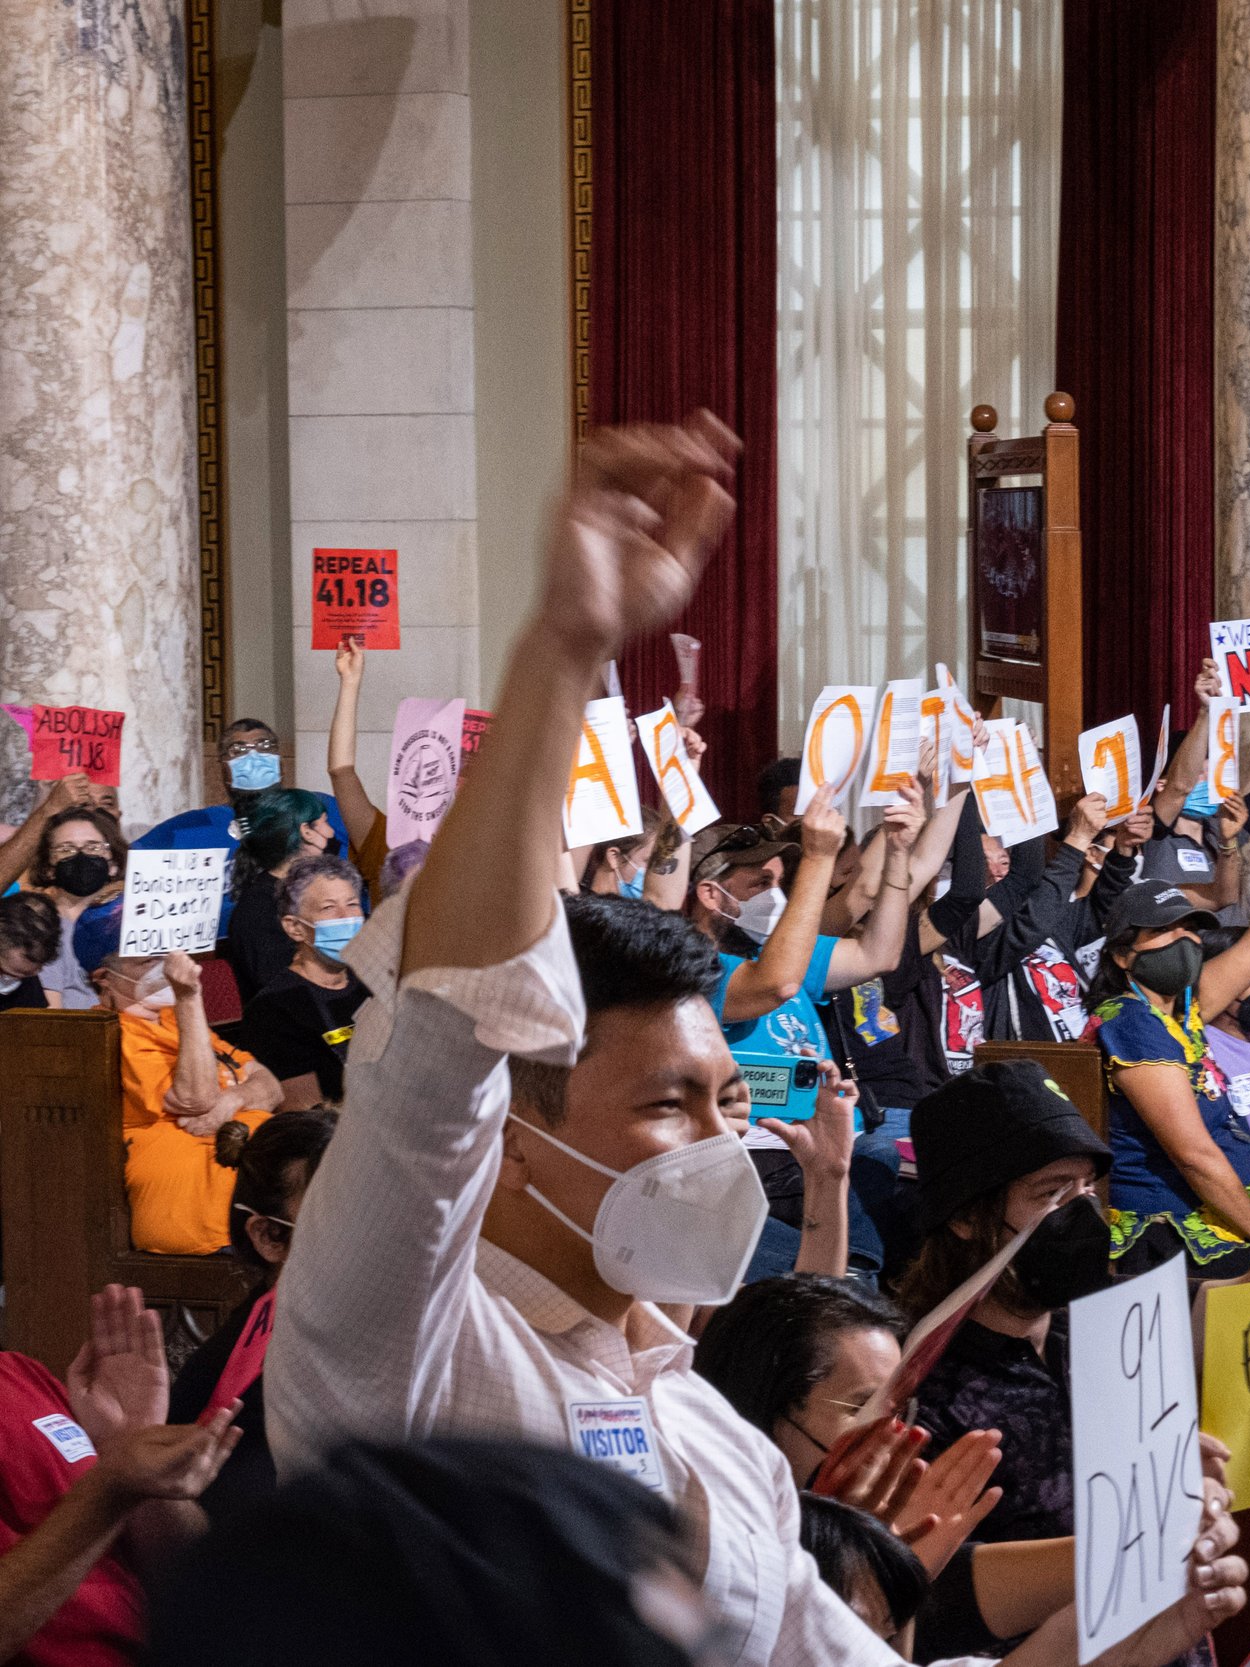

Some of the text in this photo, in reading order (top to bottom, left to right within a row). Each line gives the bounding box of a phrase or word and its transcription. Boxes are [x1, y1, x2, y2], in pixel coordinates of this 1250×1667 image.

[315, 556, 393, 574] REPEAL
[317, 578, 389, 607] 41.18
[36, 709, 125, 739] ABOLISH
[463, 721, 487, 733] REP
[808, 694, 864, 796] O
[870, 691, 914, 792] L
[565, 718, 631, 828] A
[653, 710, 695, 826] B
[1091, 731, 1134, 820] 1
[132, 871, 219, 894] Banishment
[150, 897, 210, 920] Death
[124, 925, 191, 953] ABOLISH
[743, 1071, 776, 1082] PEOPLE
[754, 1088, 785, 1100] PROFIT
[1121, 1292, 1180, 1443] 91
[580, 1426, 649, 1458] VISITOR
